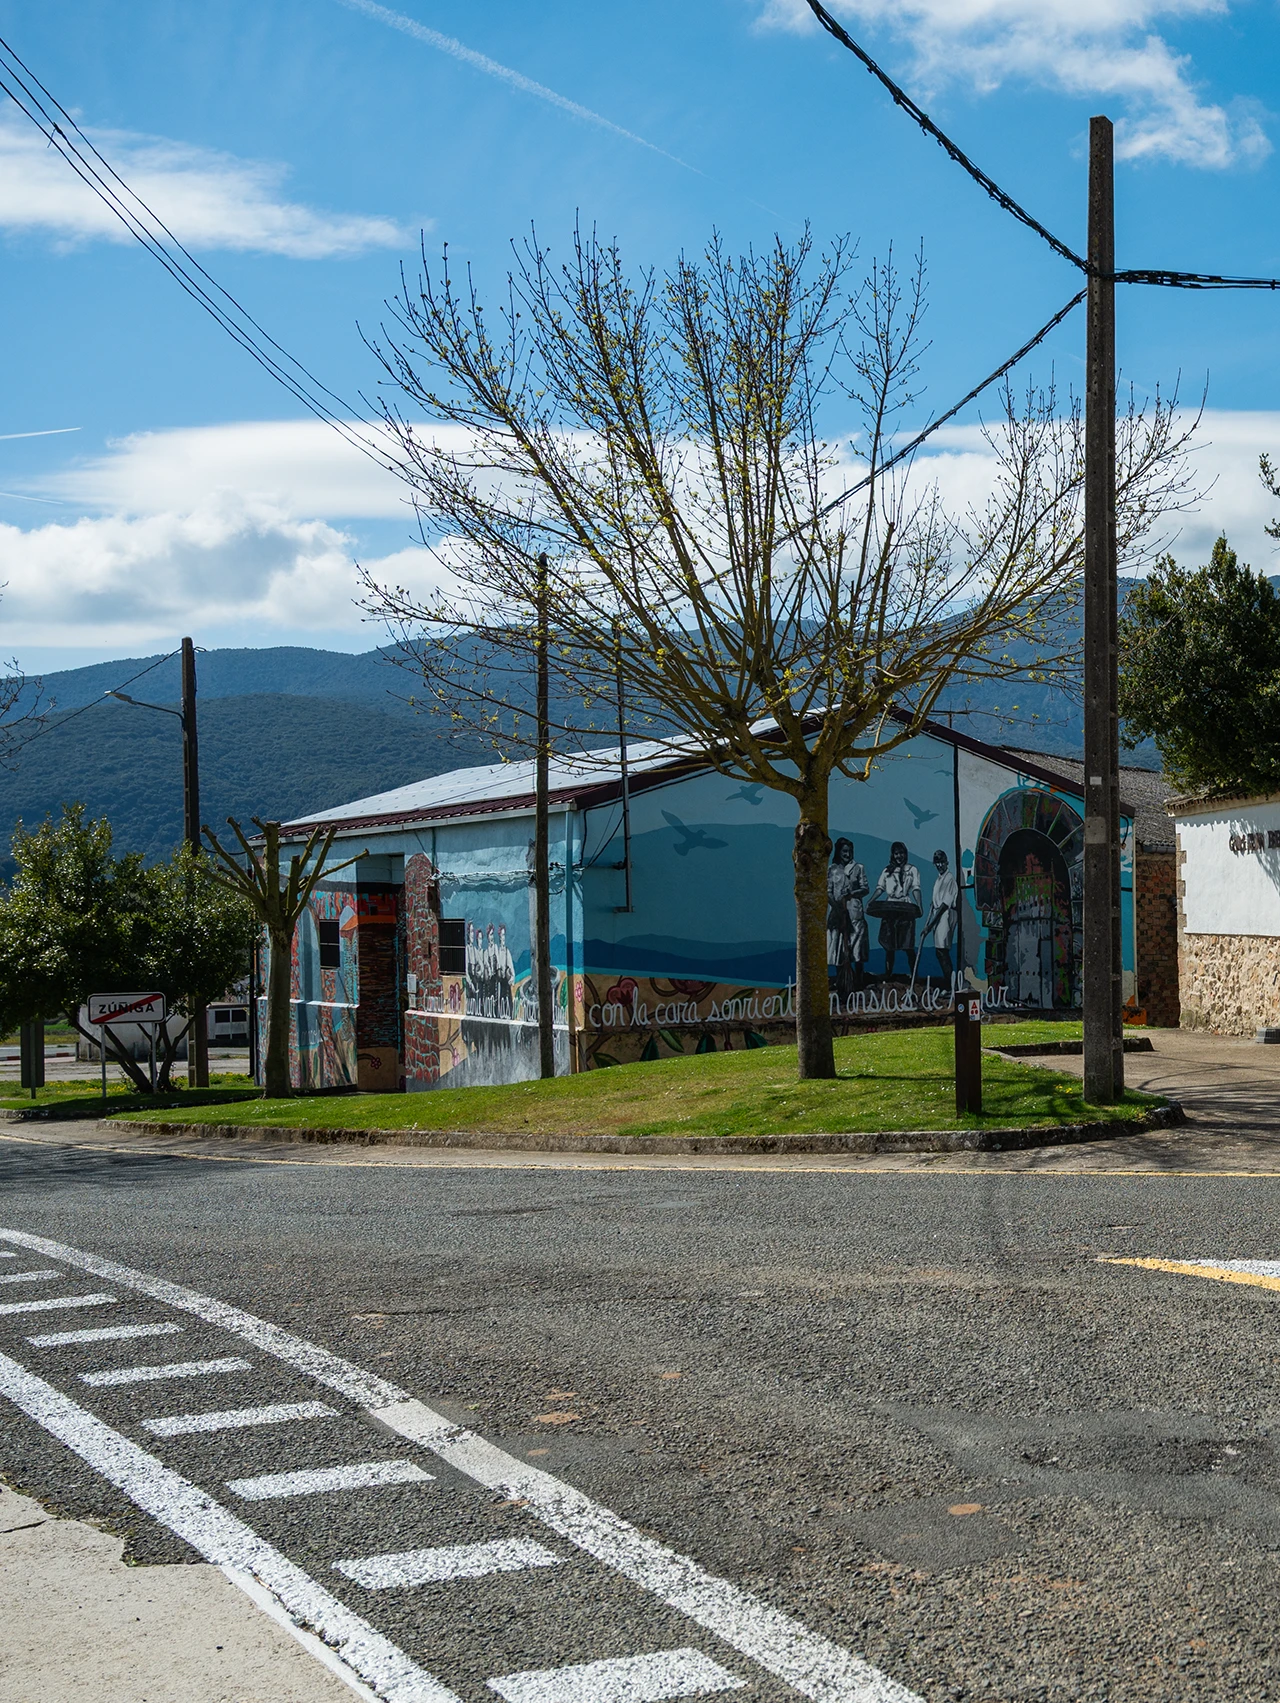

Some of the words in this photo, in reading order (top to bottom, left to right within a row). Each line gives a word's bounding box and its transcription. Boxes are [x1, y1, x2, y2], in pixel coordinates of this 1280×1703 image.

[98, 1001, 155, 1014] ZÚÑIGA
[588, 1003, 626, 1028] con
[630, 986, 653, 1026] la
[655, 1002, 704, 1026] cara
[706, 976, 797, 1023] sonrient
[846, 982, 917, 1015] ansias
[921, 975, 944, 1013] de
